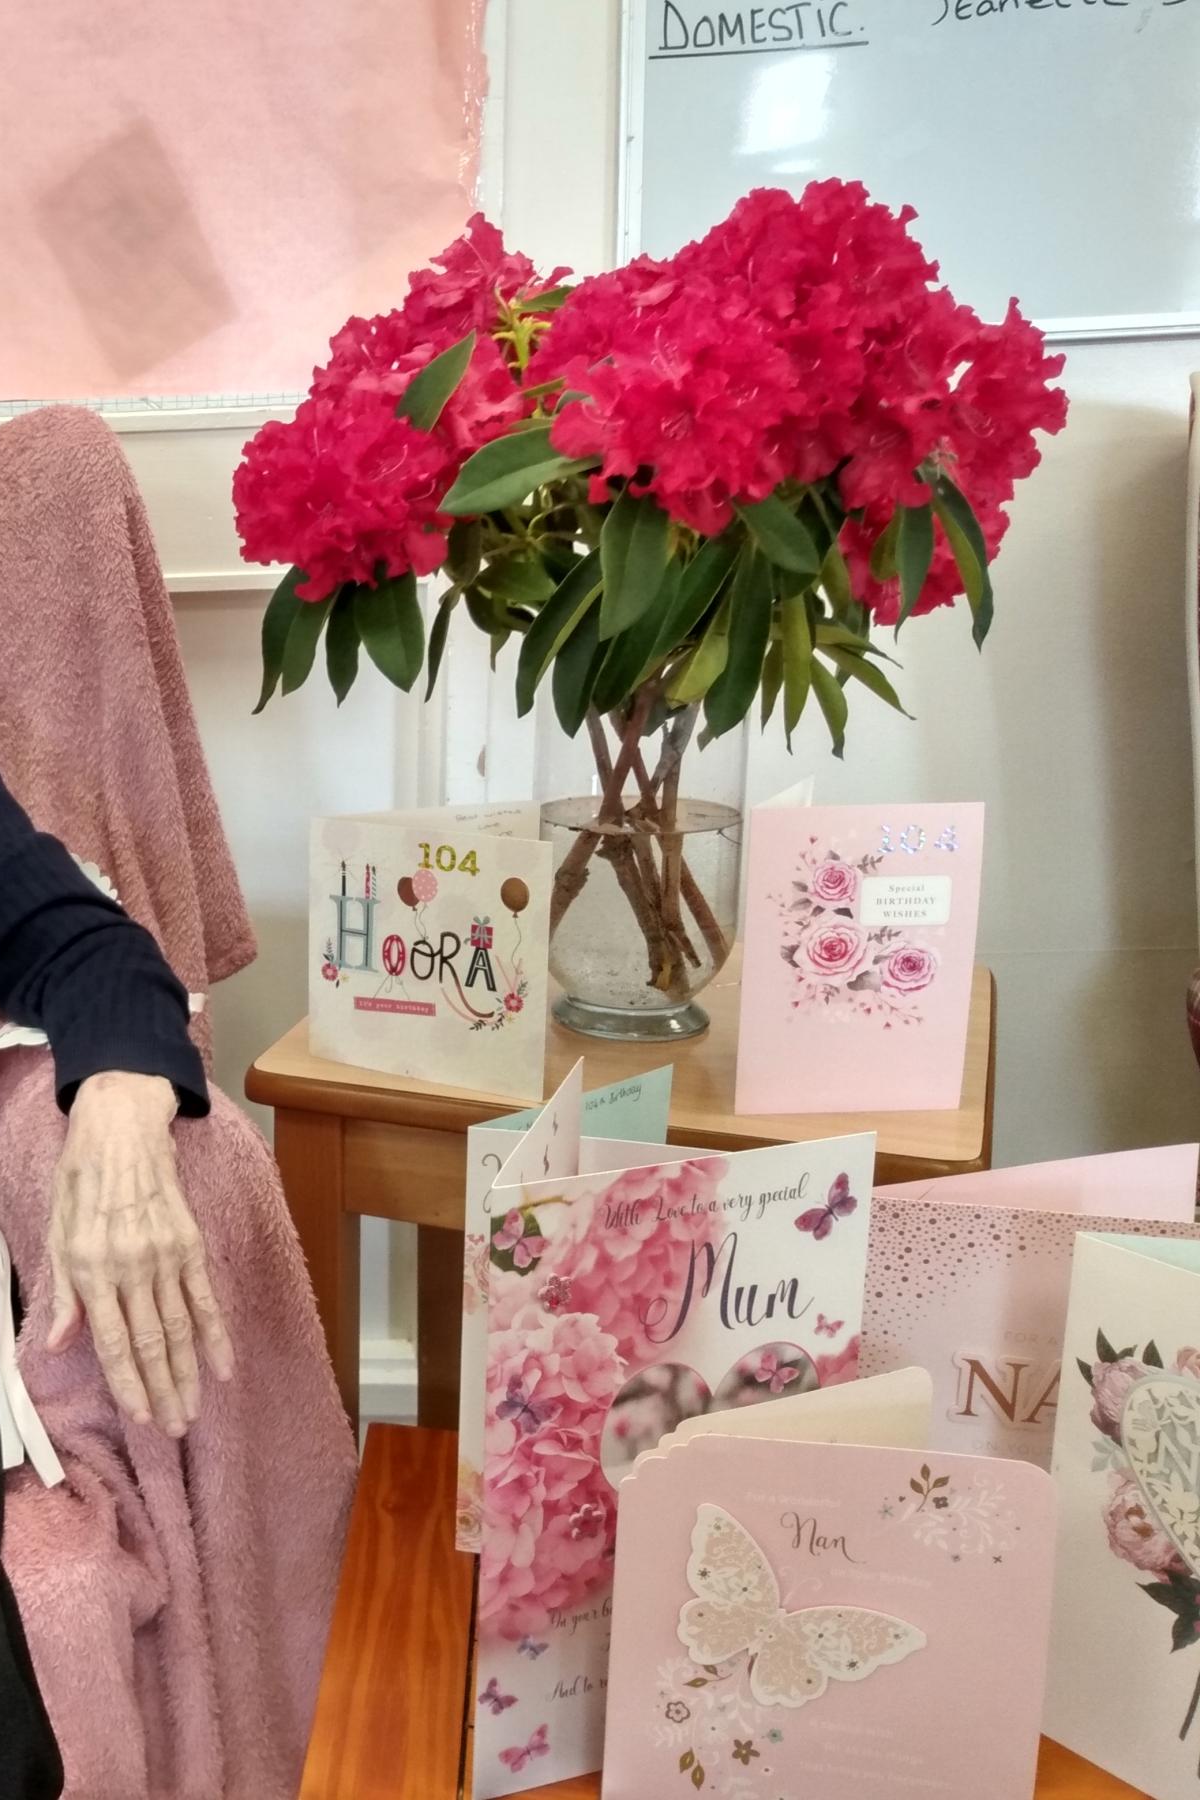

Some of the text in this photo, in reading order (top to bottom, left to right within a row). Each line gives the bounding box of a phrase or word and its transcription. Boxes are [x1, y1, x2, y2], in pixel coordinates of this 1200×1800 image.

[877, 824, 960, 855] 104
[417, 842, 480, 877] 104
[876, 896, 938, 906] BIRTHDAY
[888, 884, 925, 894] Special
[883, 909, 929, 919] WISHES
[602, 1171, 810, 1230] With Love to a very special
[638, 1231, 816, 1344] Mum
[779, 1511, 867, 1564] Nan
